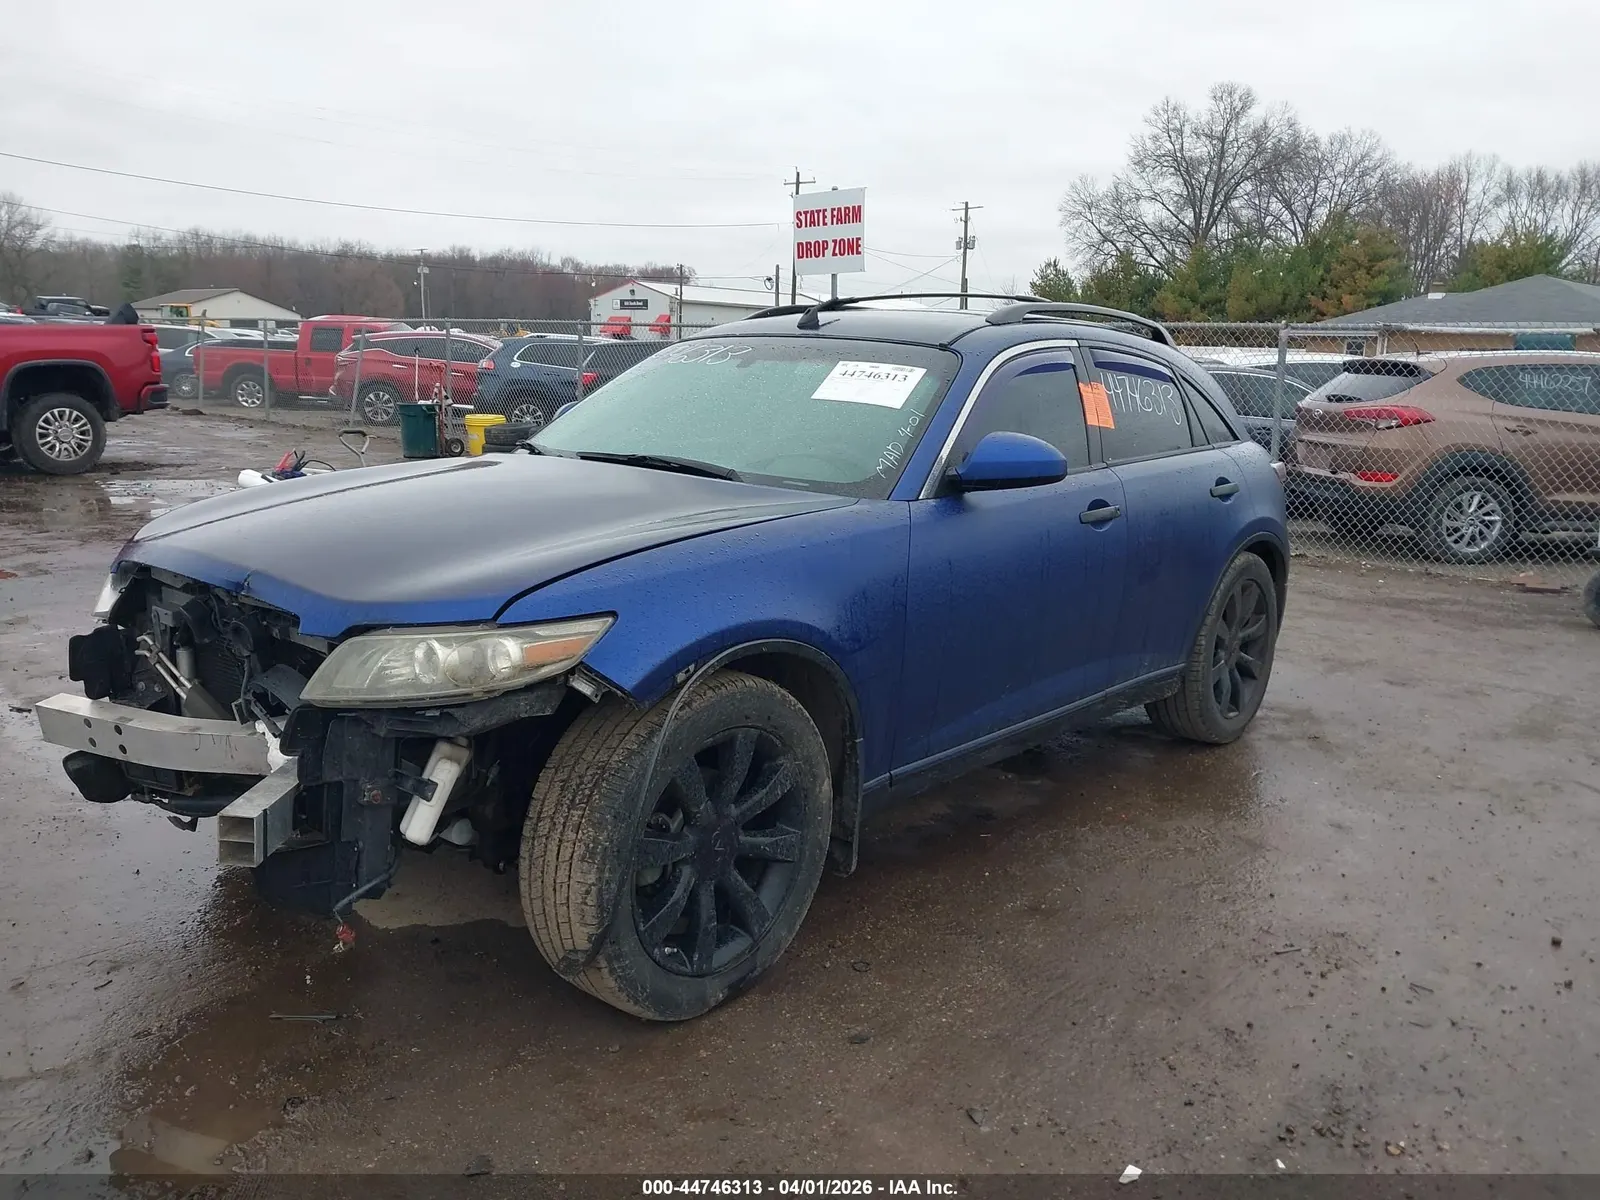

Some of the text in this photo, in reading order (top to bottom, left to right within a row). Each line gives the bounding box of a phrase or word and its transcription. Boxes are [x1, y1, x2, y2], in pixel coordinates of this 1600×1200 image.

[795, 205, 862, 229] STATE FARM
[796, 237, 862, 260] DROP ZONE
[838, 369, 909, 383] 44746313
[1100, 372, 1182, 426] 44746313
